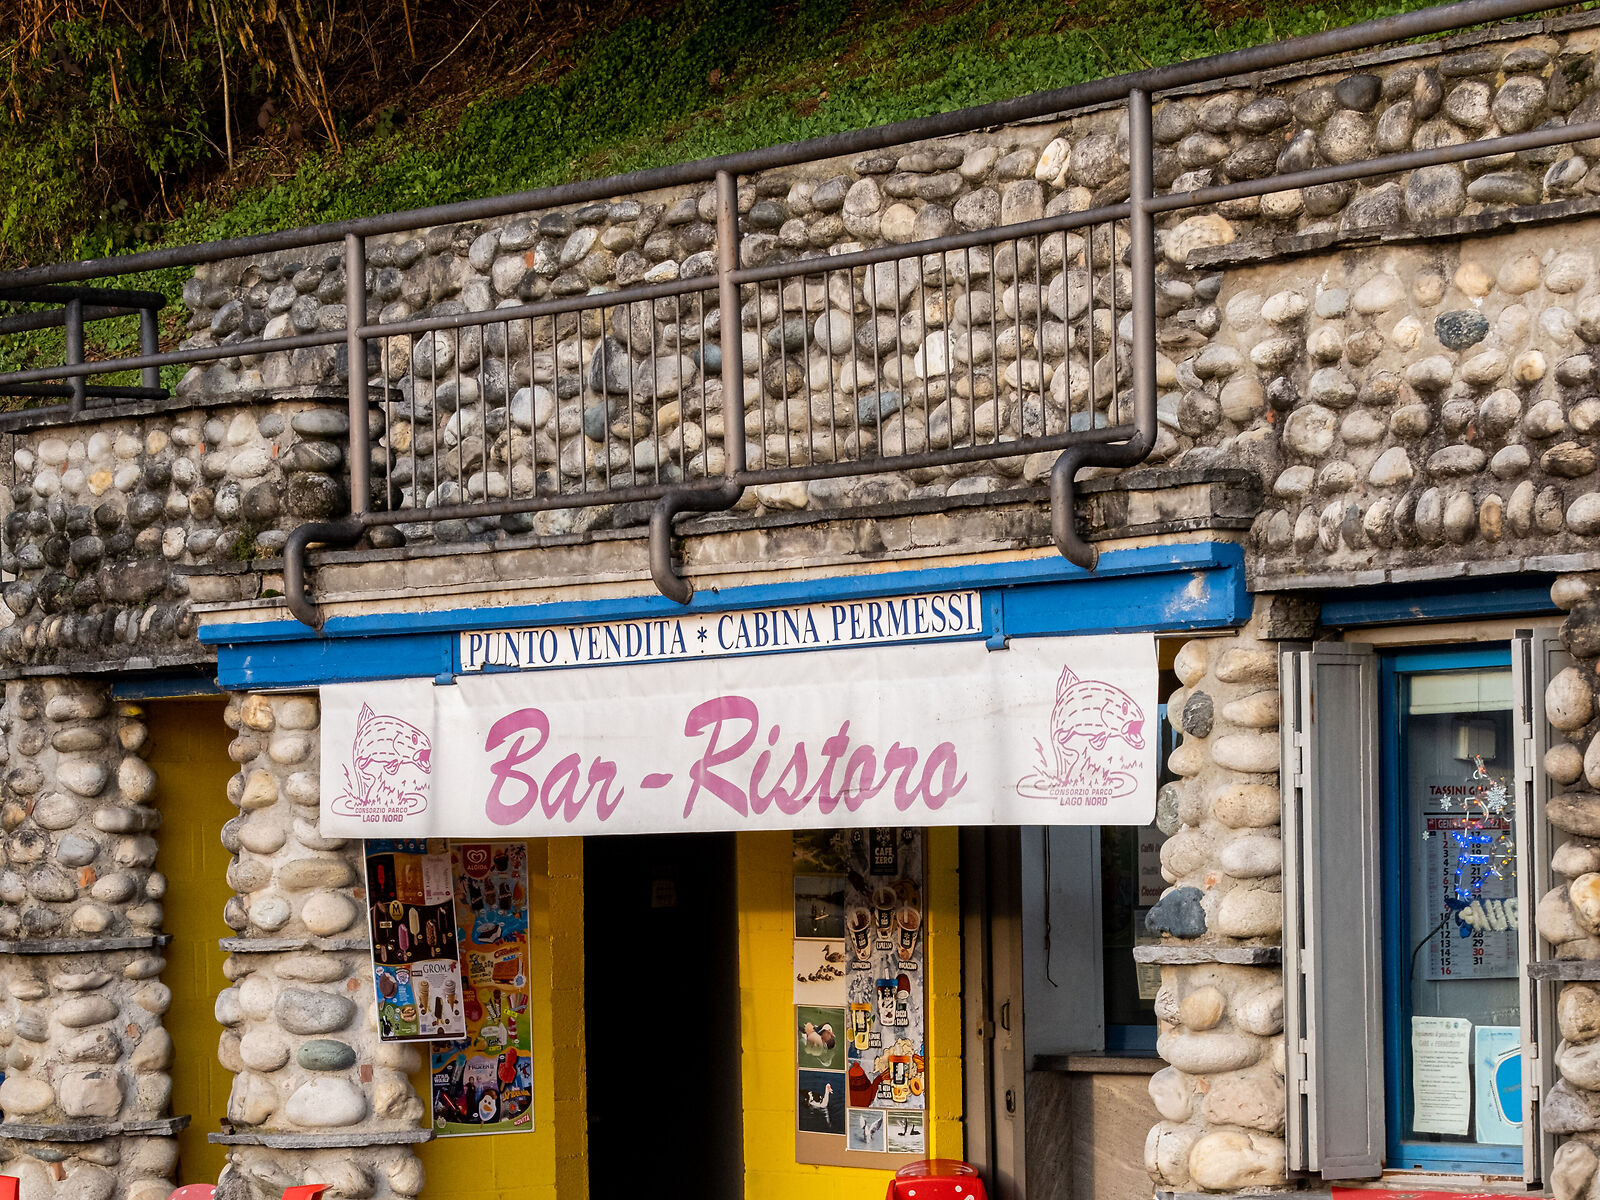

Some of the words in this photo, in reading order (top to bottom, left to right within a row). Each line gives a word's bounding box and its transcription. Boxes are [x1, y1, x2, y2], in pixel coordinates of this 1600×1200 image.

[468, 629, 558, 667] PUNTO
[568, 620, 687, 661] VENDITA
[717, 608, 820, 650] CABINA
[830, 592, 976, 641] PERMESSI
[485, 707, 624, 826] Bar
[683, 695, 967, 819] Ristoro
[1049, 788, 1089, 796] CONSORZIO
[1429, 785, 1466, 796] TASSINI
[1060, 797, 1083, 806] LAGO
[1085, 796, 1108, 806] NORD
[362, 814, 380, 823] LAGO
[382, 814, 404, 823] NORD
[1443, 840, 1449, 849] 2
[1443, 849, 1449, 857] 3
[874, 856, 893, 865] ZERO
[1443, 858, 1449, 867] 4
[1443, 867, 1449, 876] 5
[1471, 867, 1481, 875] 21
[1443, 876, 1449, 885] 6
[1471, 876, 1481, 885] 22
[1443, 885, 1449, 894] 7
[1440, 930, 1450, 939] 12
[1472, 930, 1484, 938] 28
[1440, 939, 1451, 948] 13
[1472, 939, 1484, 947] 29
[1440, 948, 1451, 957] 14
[1472, 948, 1484, 956] 30
[1440, 957, 1451, 966] 15
[1473, 956, 1484, 965] 31
[422, 963, 447, 974] GROM
[1440, 966, 1452, 975] 16
